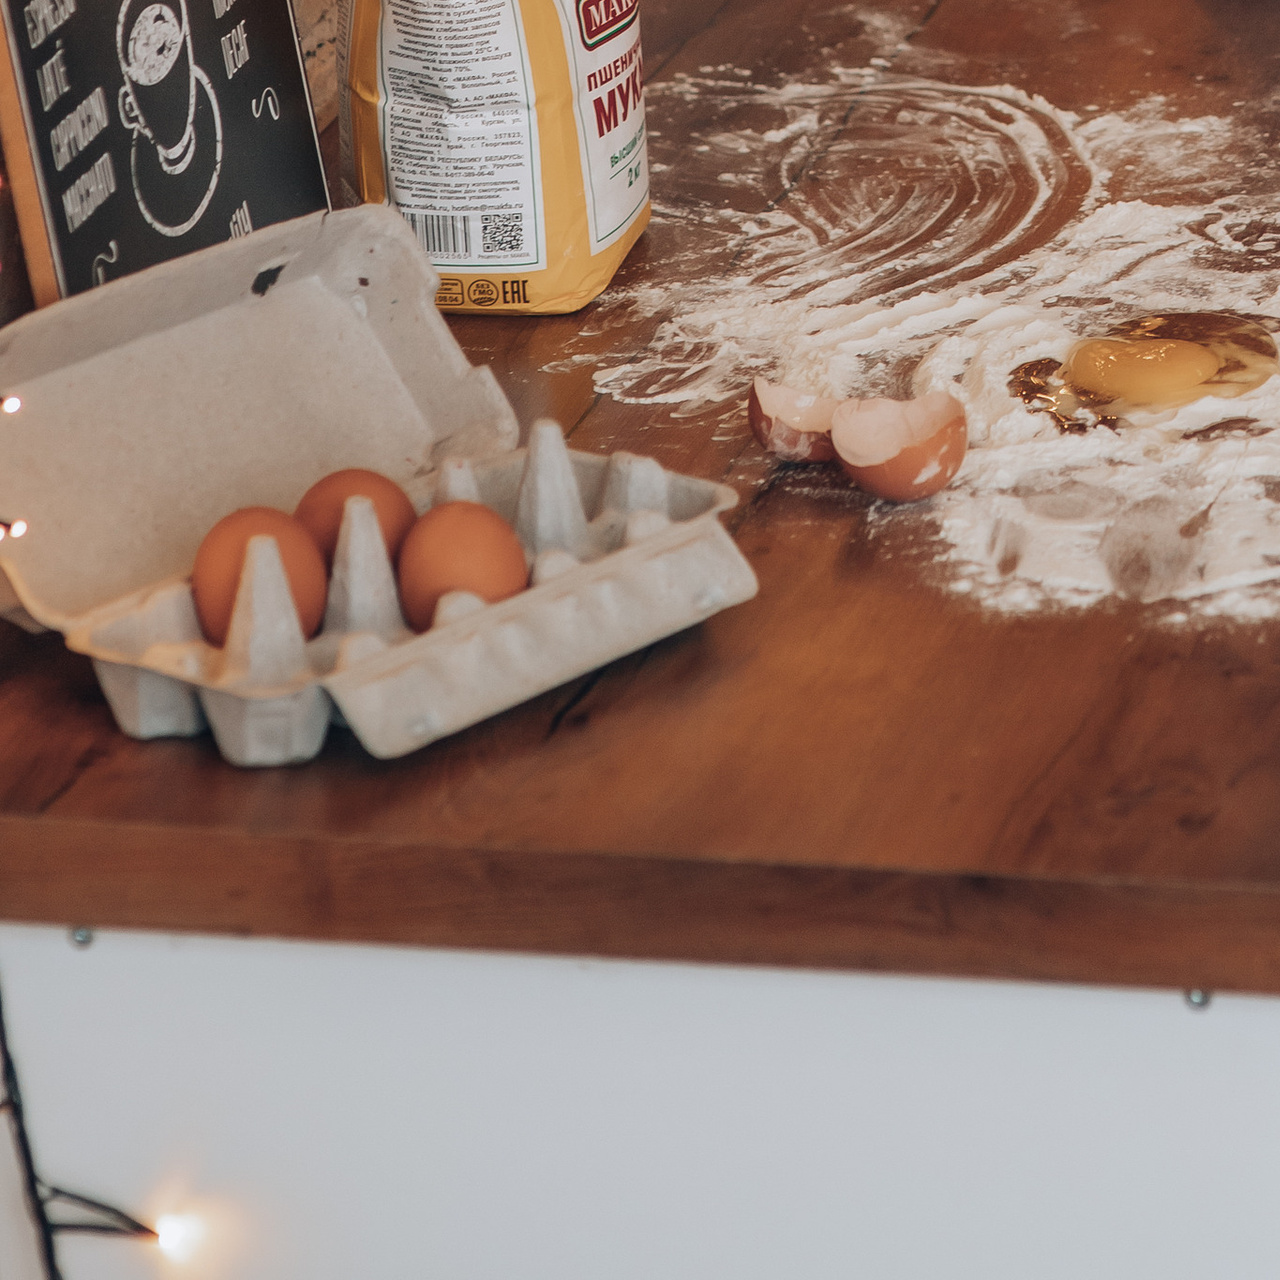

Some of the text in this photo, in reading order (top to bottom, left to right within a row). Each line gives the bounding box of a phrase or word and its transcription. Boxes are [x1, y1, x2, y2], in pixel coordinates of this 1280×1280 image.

[220, 19, 250, 80] DECAF
[627, 168, 633, 189] 2
[451, 202, 524, 212] hotline@makfa.ru
